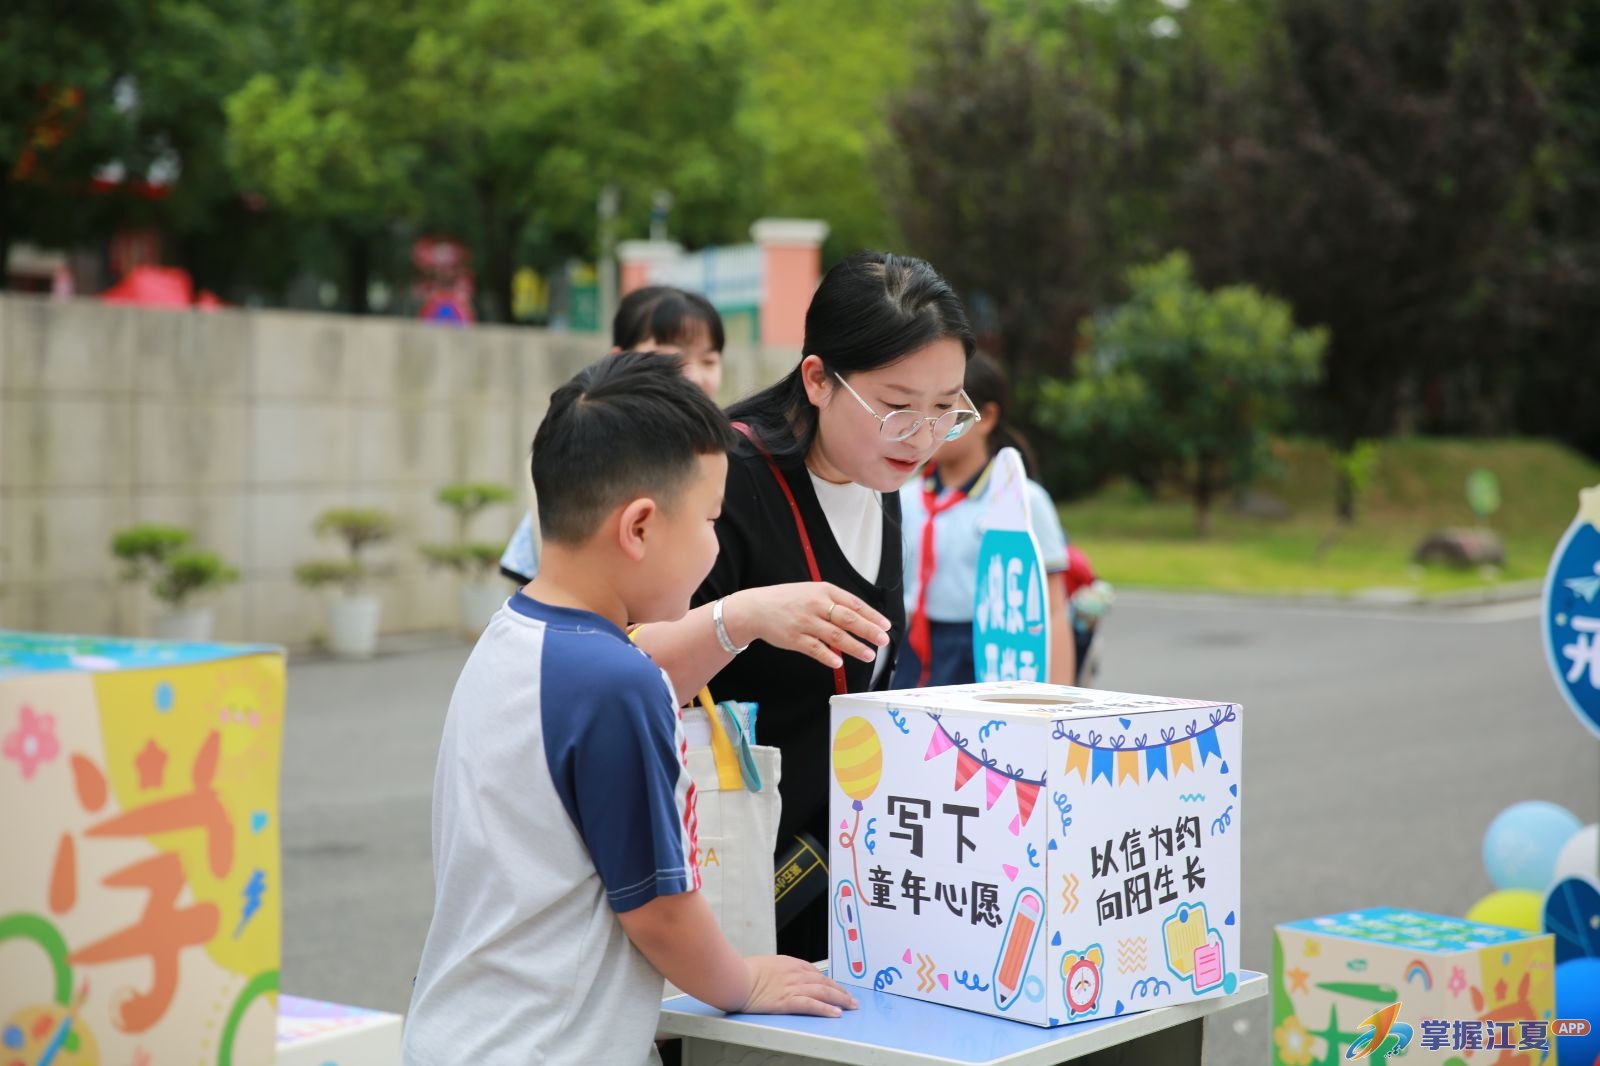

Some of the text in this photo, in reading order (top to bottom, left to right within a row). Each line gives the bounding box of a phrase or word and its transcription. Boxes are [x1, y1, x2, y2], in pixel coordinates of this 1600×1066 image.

[887, 795, 979, 864] 写下
[1090, 815, 1202, 880] 以信为约
[868, 864, 1003, 928] 童年心愿
[1096, 855, 1206, 926] 向阳生长
